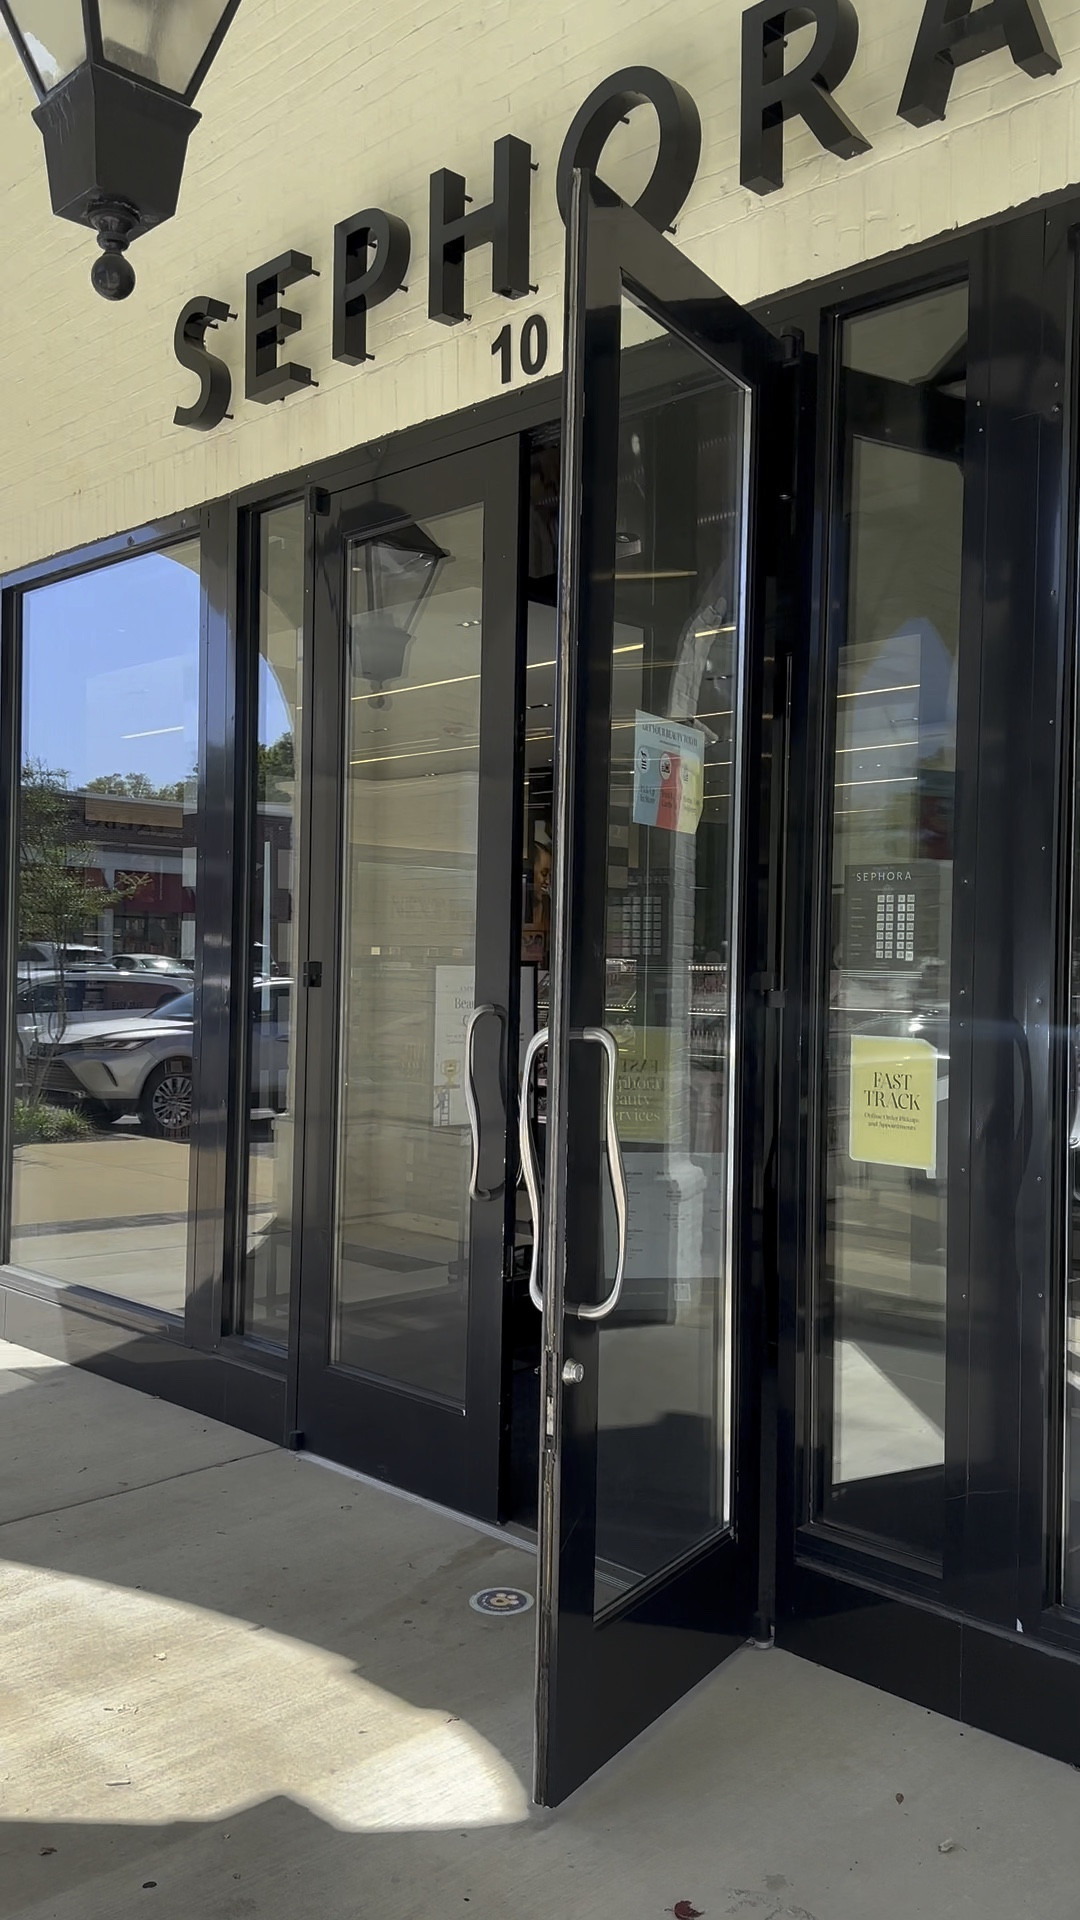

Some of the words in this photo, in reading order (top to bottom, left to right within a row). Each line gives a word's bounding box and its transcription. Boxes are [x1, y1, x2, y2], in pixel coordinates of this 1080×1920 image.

[172, 0, 1062, 432] SEPHORA
[491, 313, 548, 384] 10
[665, 728, 683, 742] BEAUTY
[856, 871, 912, 882] SEPHORA
[873, 1071, 912, 1090] FAST
[864, 1089, 921, 1111] TRACK
[615, 1108, 660, 1121] rvices
